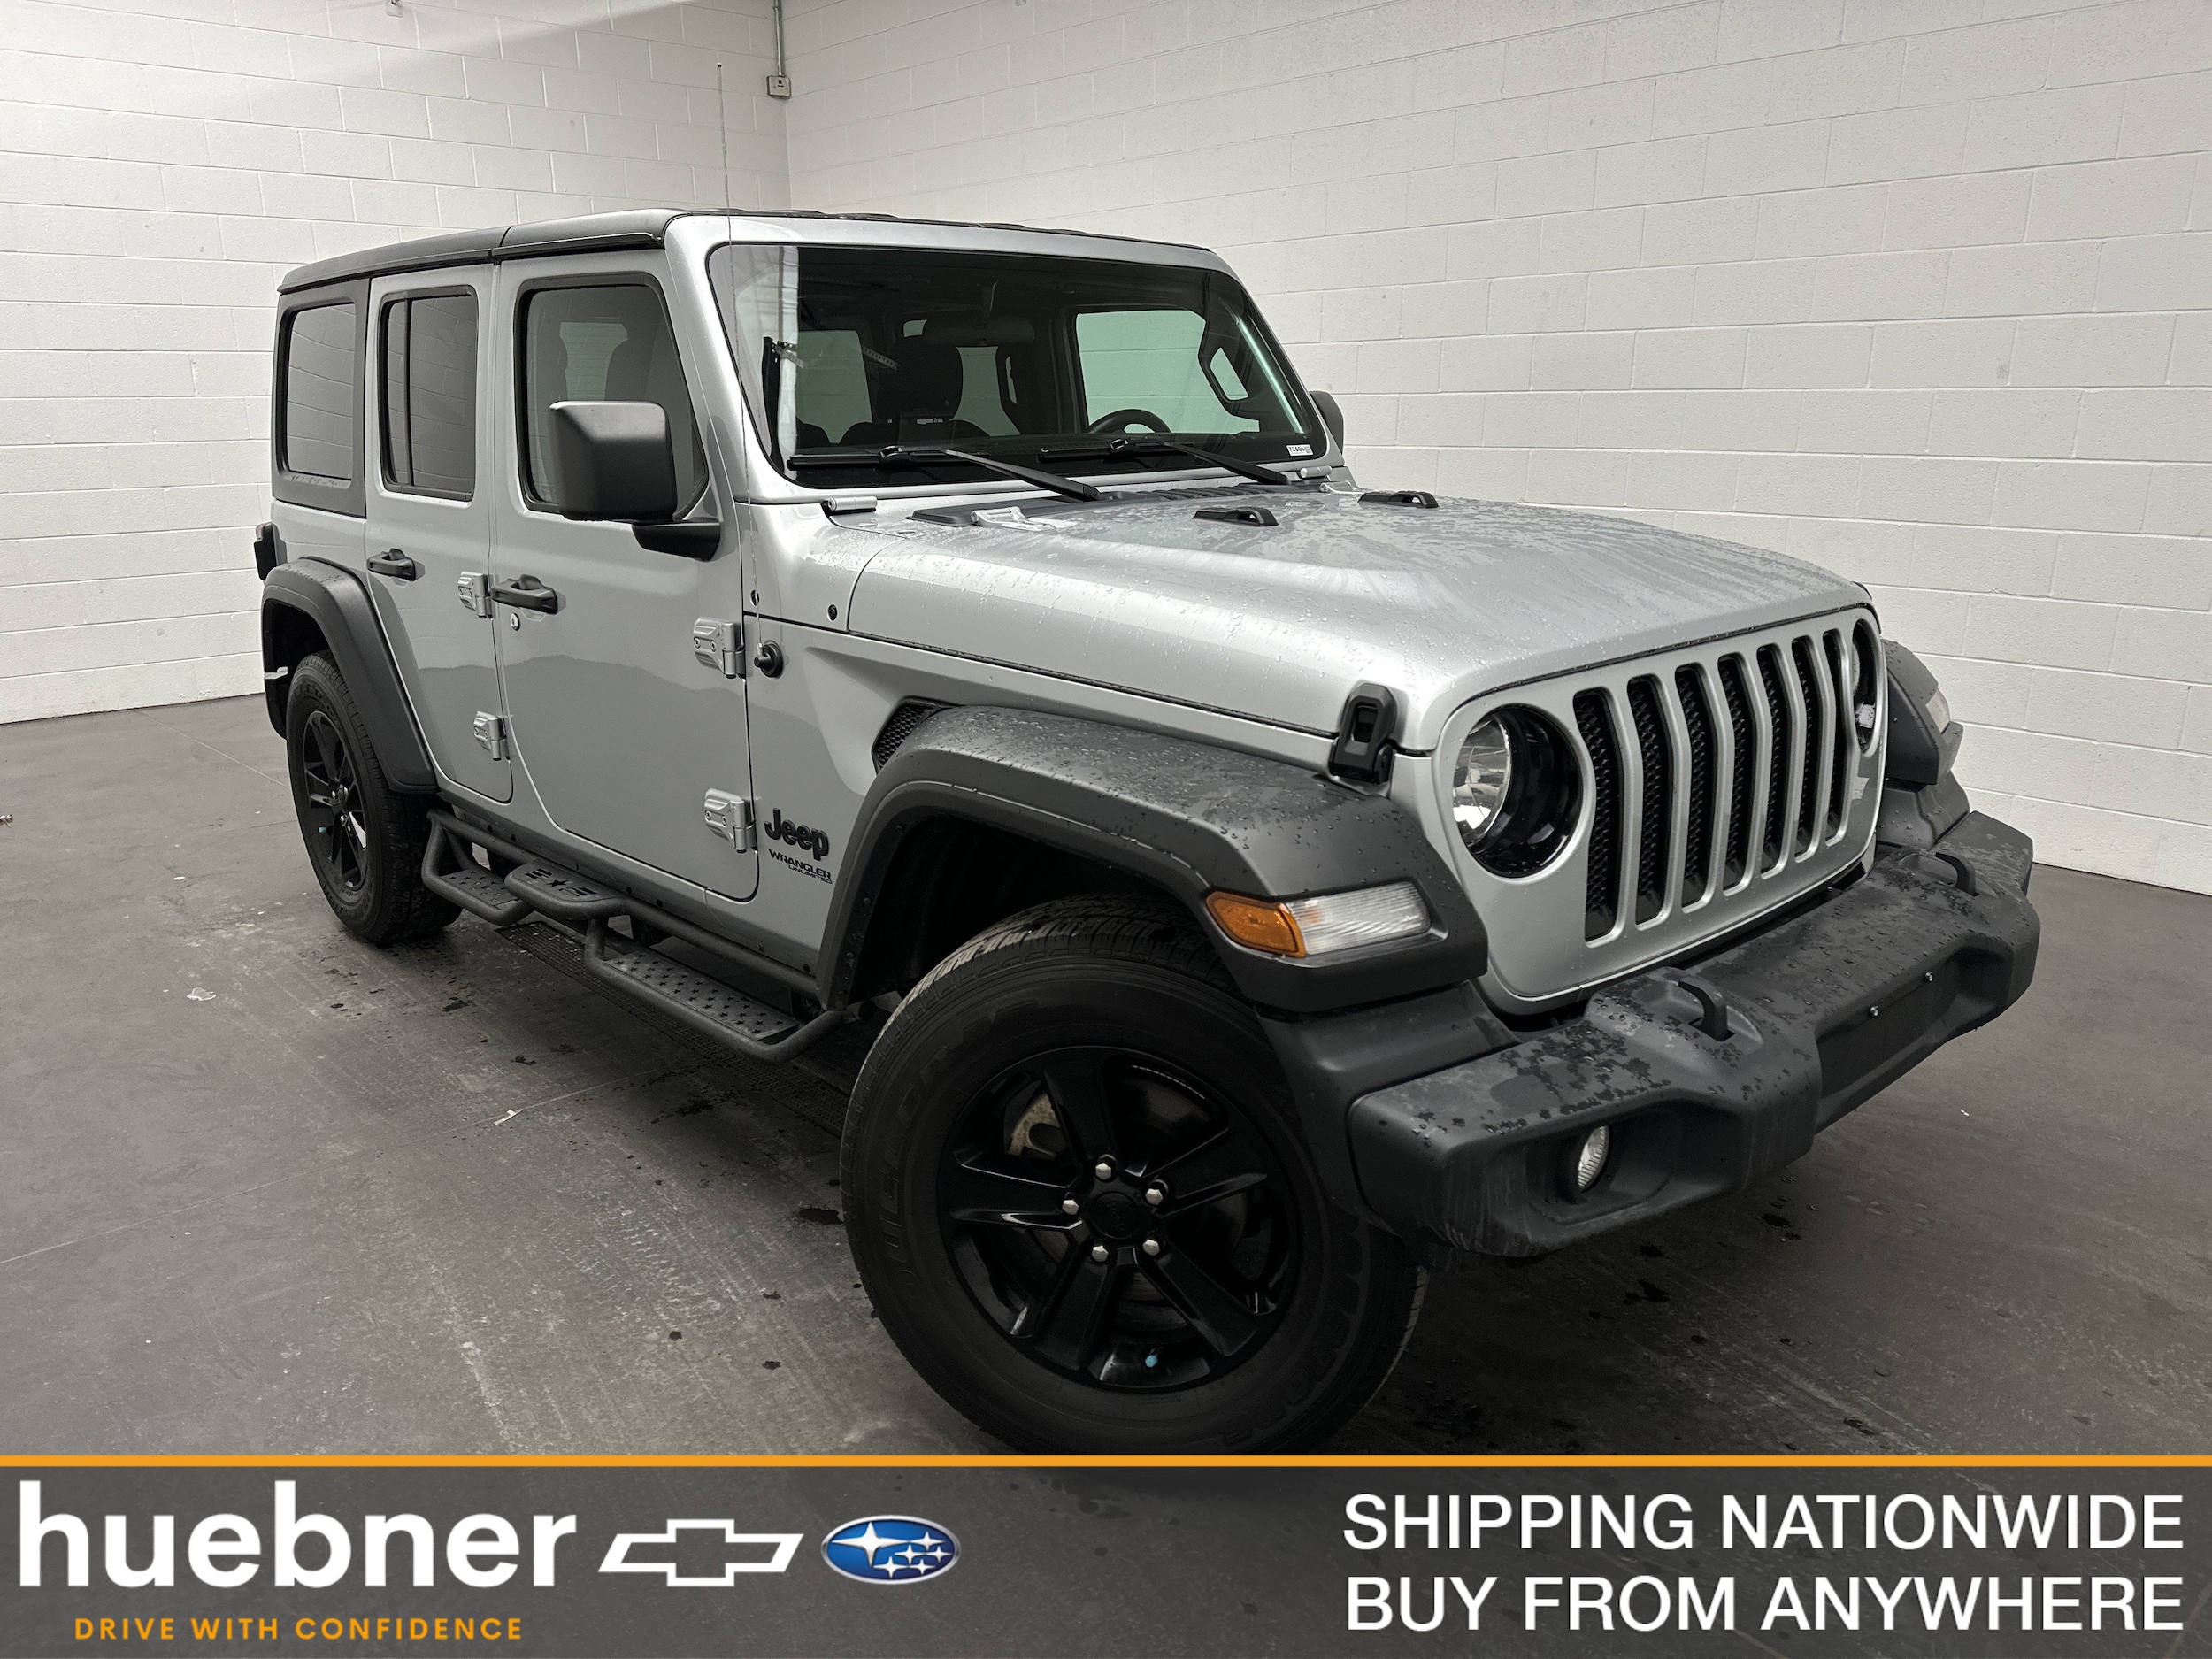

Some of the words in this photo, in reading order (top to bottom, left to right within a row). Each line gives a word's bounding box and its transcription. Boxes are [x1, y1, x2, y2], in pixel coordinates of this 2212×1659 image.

[764, 808, 830, 861] Jeep
[768, 849, 832, 880] WRANGLER
[788, 864, 833, 884] UNLIMITED
